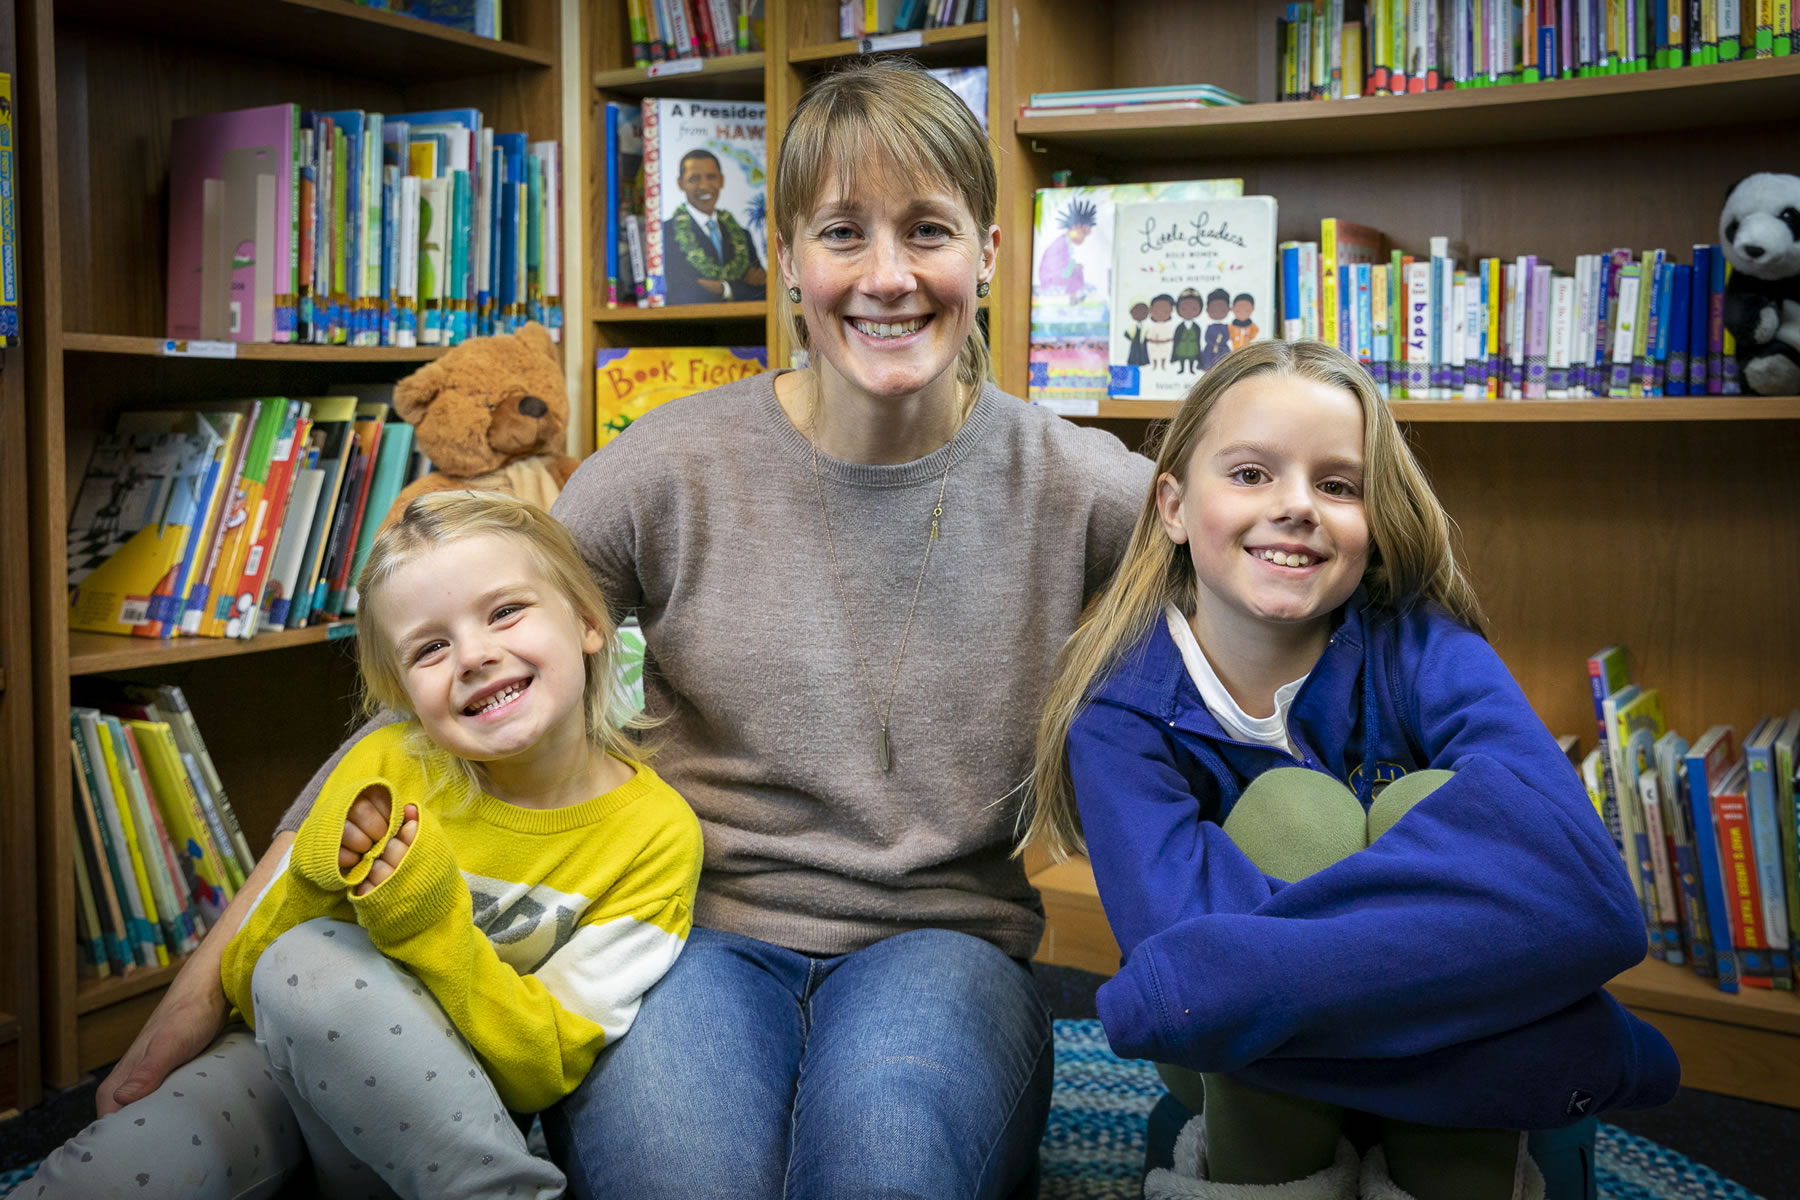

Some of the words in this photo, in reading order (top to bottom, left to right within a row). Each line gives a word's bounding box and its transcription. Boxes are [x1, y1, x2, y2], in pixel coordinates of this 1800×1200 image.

[671, 105, 683, 117] A
[679, 122, 709, 141] from
[715, 124, 766, 139] HAW
[1188, 212, 1247, 248] Leaders
[4, 244, 14, 299] DINOSAURS
[1161, 275, 1183, 283] BLACK
[1186, 274, 1221, 282] HISTORY
[1410, 303, 1428, 350] body
[607, 359, 678, 399] Book
[688, 357, 762, 385] Fiest
[1729, 827, 1745, 860] WHO'S
[1734, 862, 1751, 897] UNDER
[1740, 899, 1755, 925] THAT
